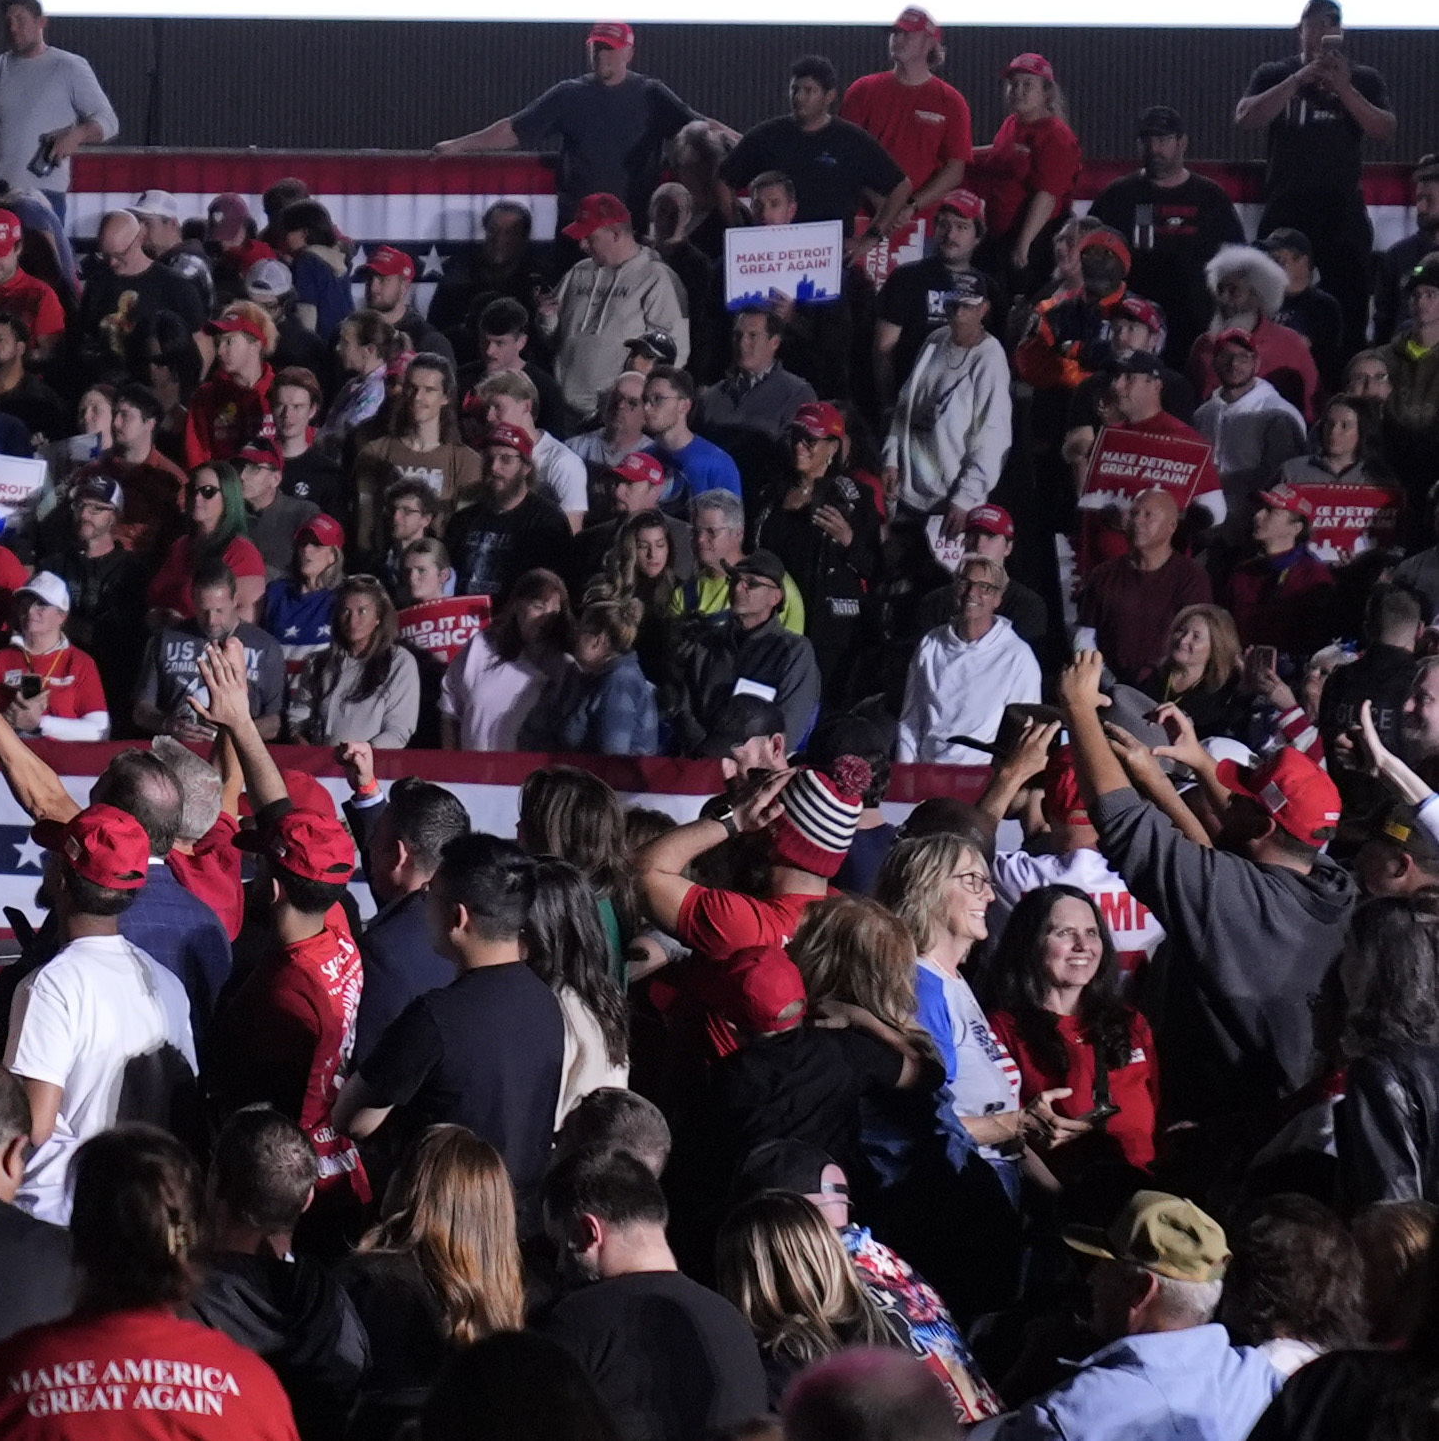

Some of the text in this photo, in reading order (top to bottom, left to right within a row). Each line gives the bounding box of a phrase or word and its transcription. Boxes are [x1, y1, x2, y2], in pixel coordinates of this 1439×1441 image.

[736, 246, 833, 264] MAKE DETROIT
[739, 258, 831, 275] GREAT AGAIN!
[1100, 451, 1197, 475] MAKE DETROIT
[1099, 463, 1190, 486] GREAT AGAIN!
[439, 616, 456, 631] IT
[461, 615, 480, 628] IN
[166, 640, 195, 662] US
[9, 1359, 241, 1396] MAKE AMERICA
[27, 1384, 223, 1418] GREAT AGAIN
